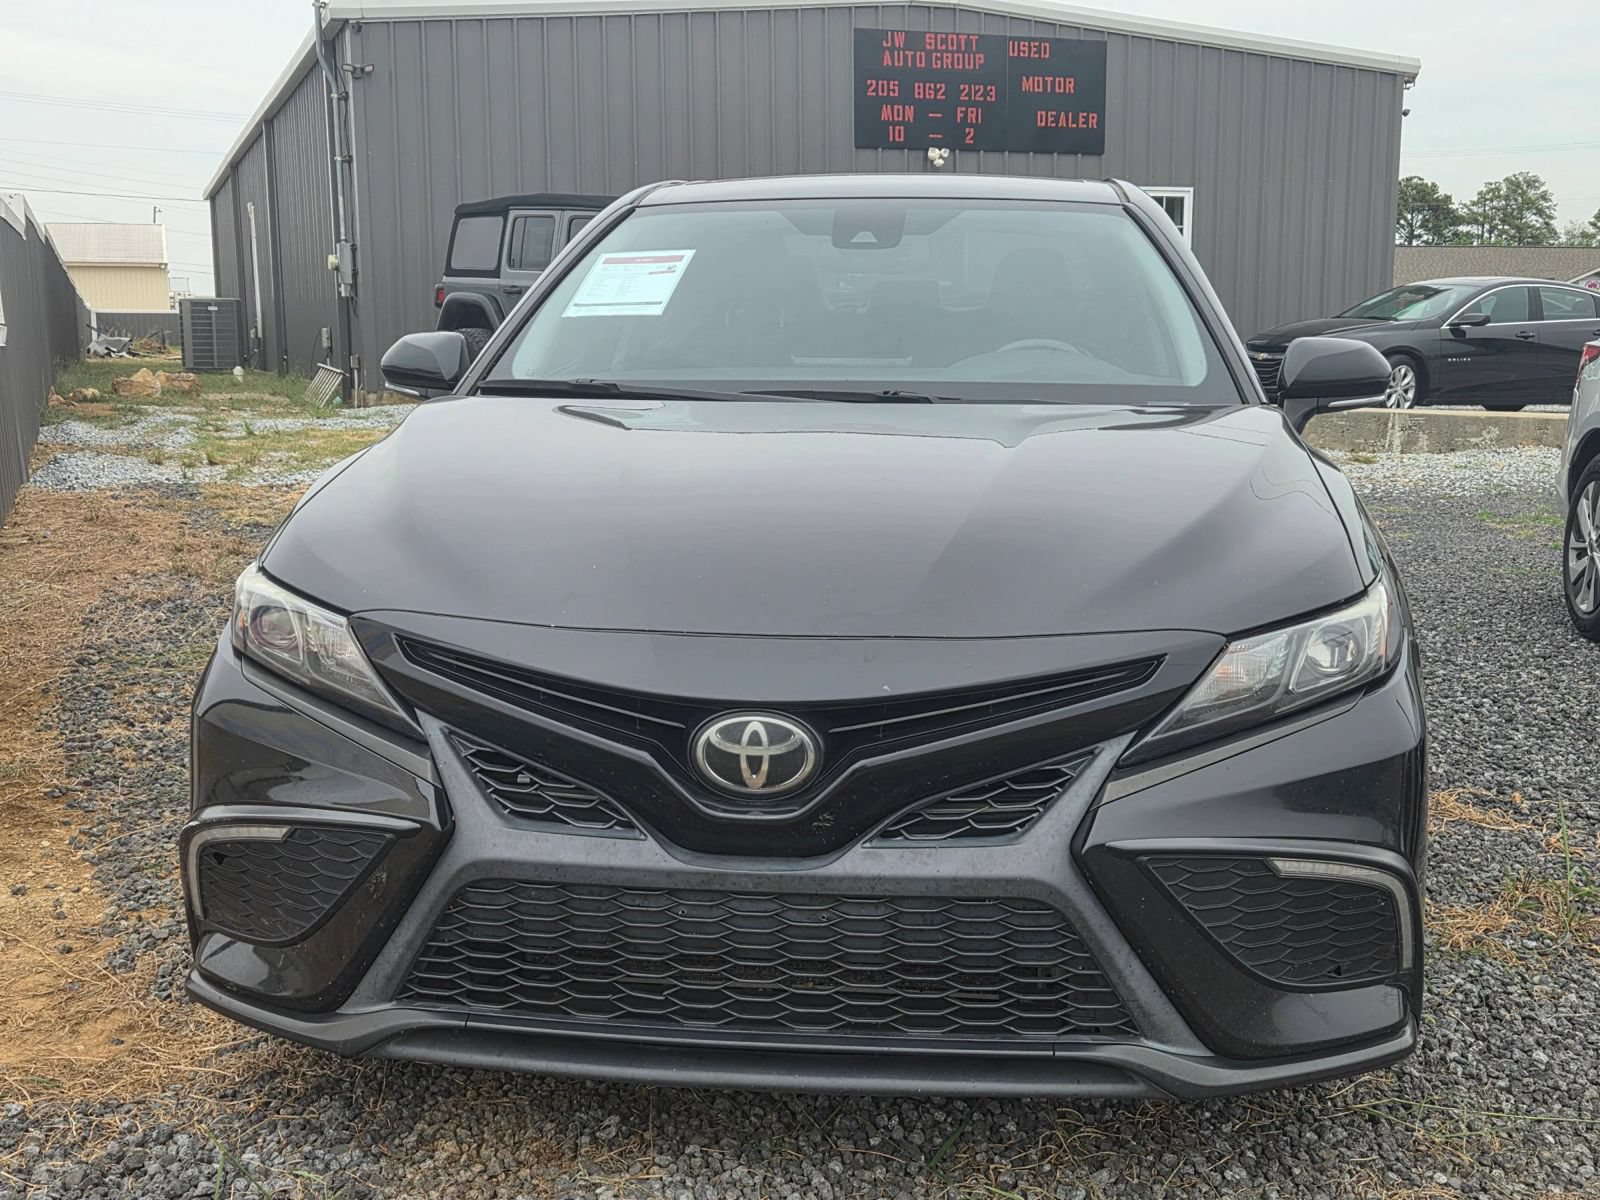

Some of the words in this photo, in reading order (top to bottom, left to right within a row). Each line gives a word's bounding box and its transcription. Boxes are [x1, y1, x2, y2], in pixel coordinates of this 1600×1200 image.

[883, 31, 905, 48] JW
[925, 32, 978, 51] SCOTT
[1009, 40, 1050, 59] USED
[883, 51, 926, 67] AUTO
[932, 53, 985, 70] GROUP
[867, 79, 899, 97] 205
[959, 84, 996, 102] 2123
[1021, 75, 1075, 94] MOTOR
[880, 104, 914, 123] MON
[956, 106, 982, 124] FRI
[1037, 110, 1098, 129] DEALER
[888, 125, 904, 142] 10
[964, 127, 974, 144] 2
